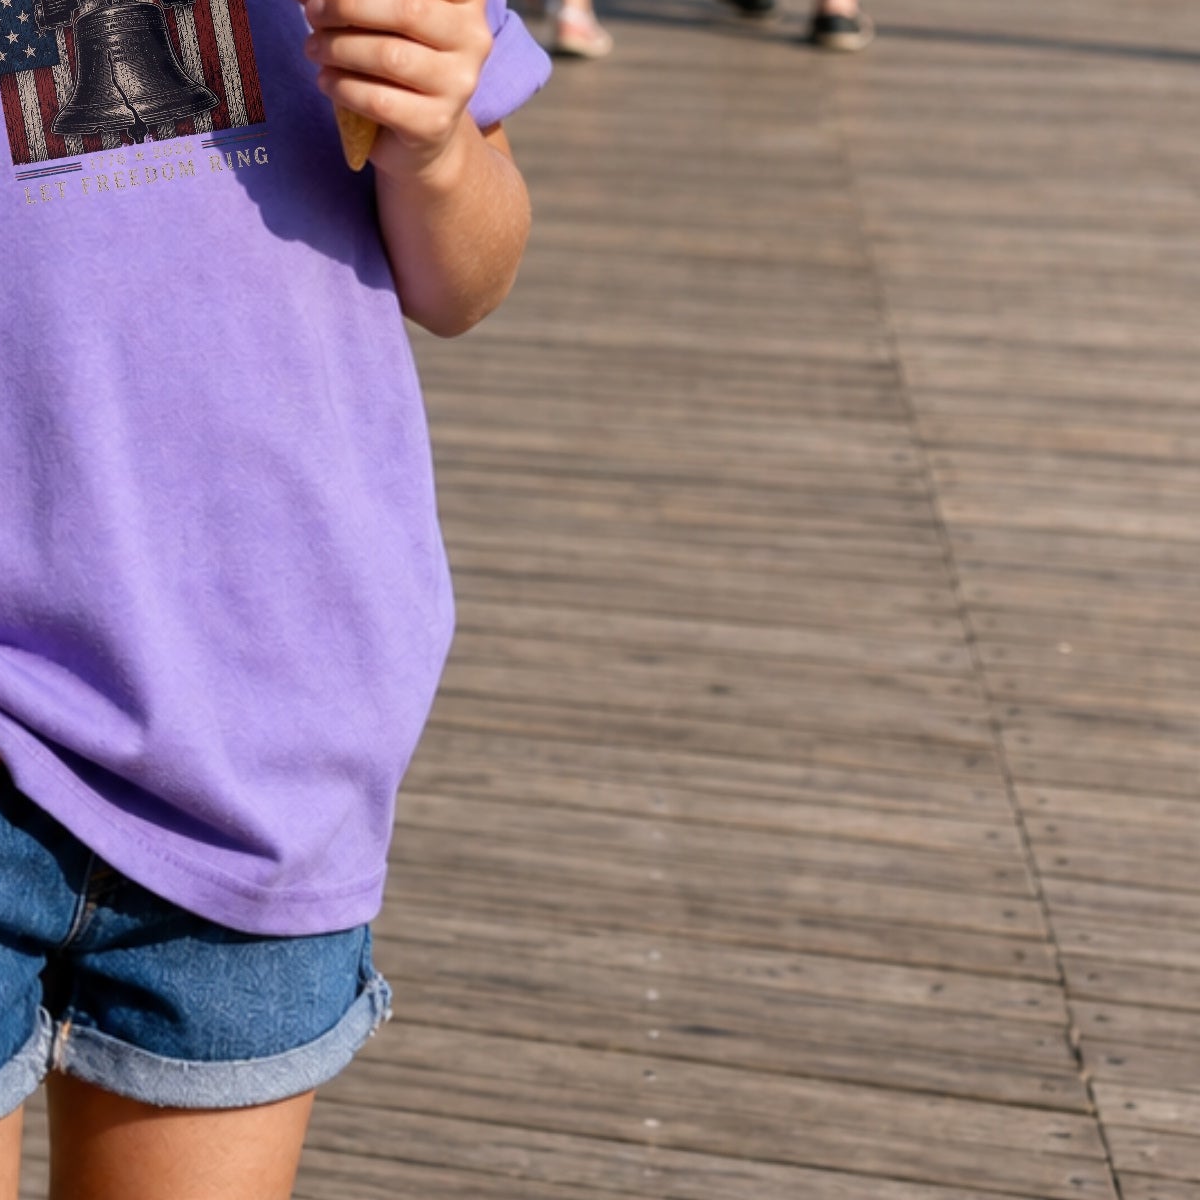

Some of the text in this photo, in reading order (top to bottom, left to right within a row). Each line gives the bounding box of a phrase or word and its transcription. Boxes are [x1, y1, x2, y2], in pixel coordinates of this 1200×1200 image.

[24, 146, 269, 205] LET FREEDOM RING
[90, 151, 126, 170] 1776
